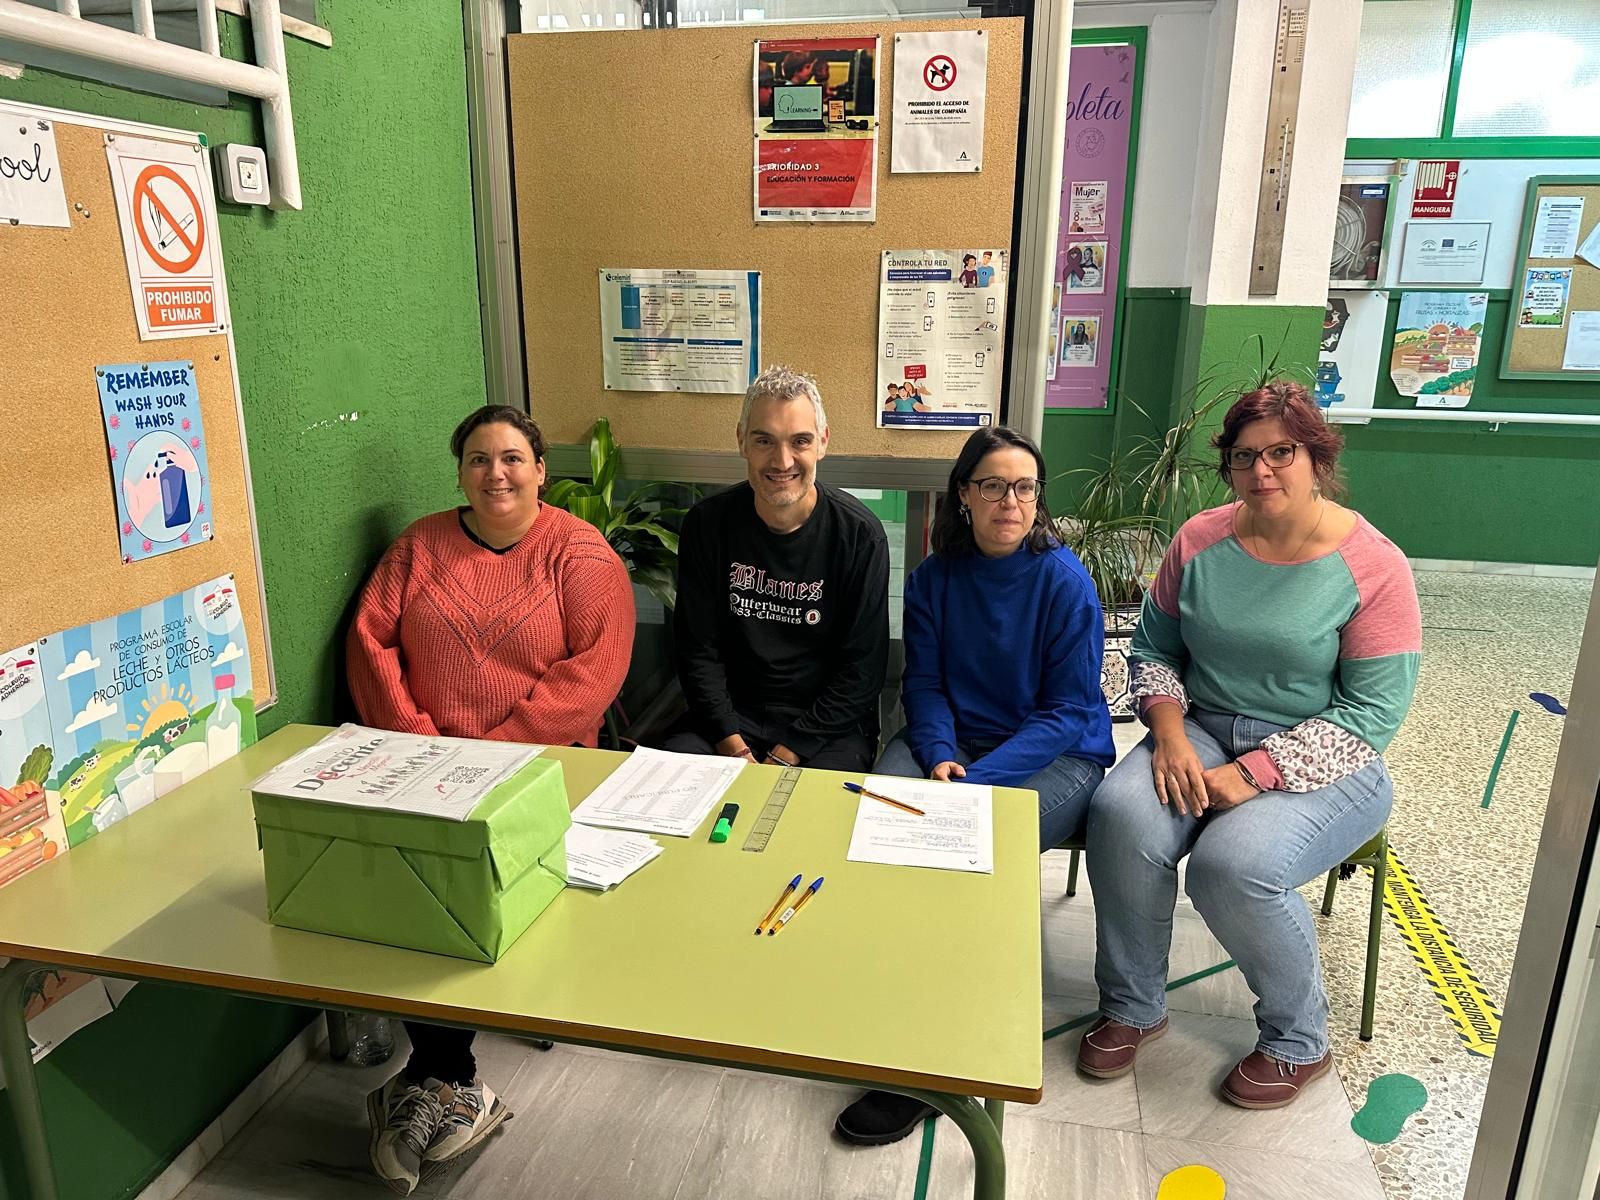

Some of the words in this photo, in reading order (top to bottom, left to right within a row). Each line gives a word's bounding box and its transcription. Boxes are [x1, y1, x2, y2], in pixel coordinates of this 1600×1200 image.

[814, 163, 820, 171] 3
[1075, 187, 1101, 198] Mujer
[146, 290, 212, 306] PROHIBIDO
[160, 306, 202, 323] FUMAR
[106, 369, 190, 395] REMEMBER
[115, 394, 152, 413] WASH
[156, 393, 187, 409] YOUR
[135, 412, 175, 429] HANDS
[730, 562, 824, 602] Blanes
[109, 629, 158, 653] PROGRAMA
[161, 615, 192, 634] ESCOLAR
[119, 650, 131, 662] DE
[134, 633, 175, 656] CONSUMO
[177, 628, 187, 640] DE
[113, 656, 149, 681] LECHE
[165, 637, 200, 660] OTROS
[93, 665, 163, 704] PRODUCTOS
[167, 645, 215, 675] LÁCTEOS
[1386, 881, 1424, 920] MANTENGA
[1409, 921, 1430, 931] LA
[1416, 932, 1458, 974] DISTANCIA
[1442, 976, 1467, 989] DE
